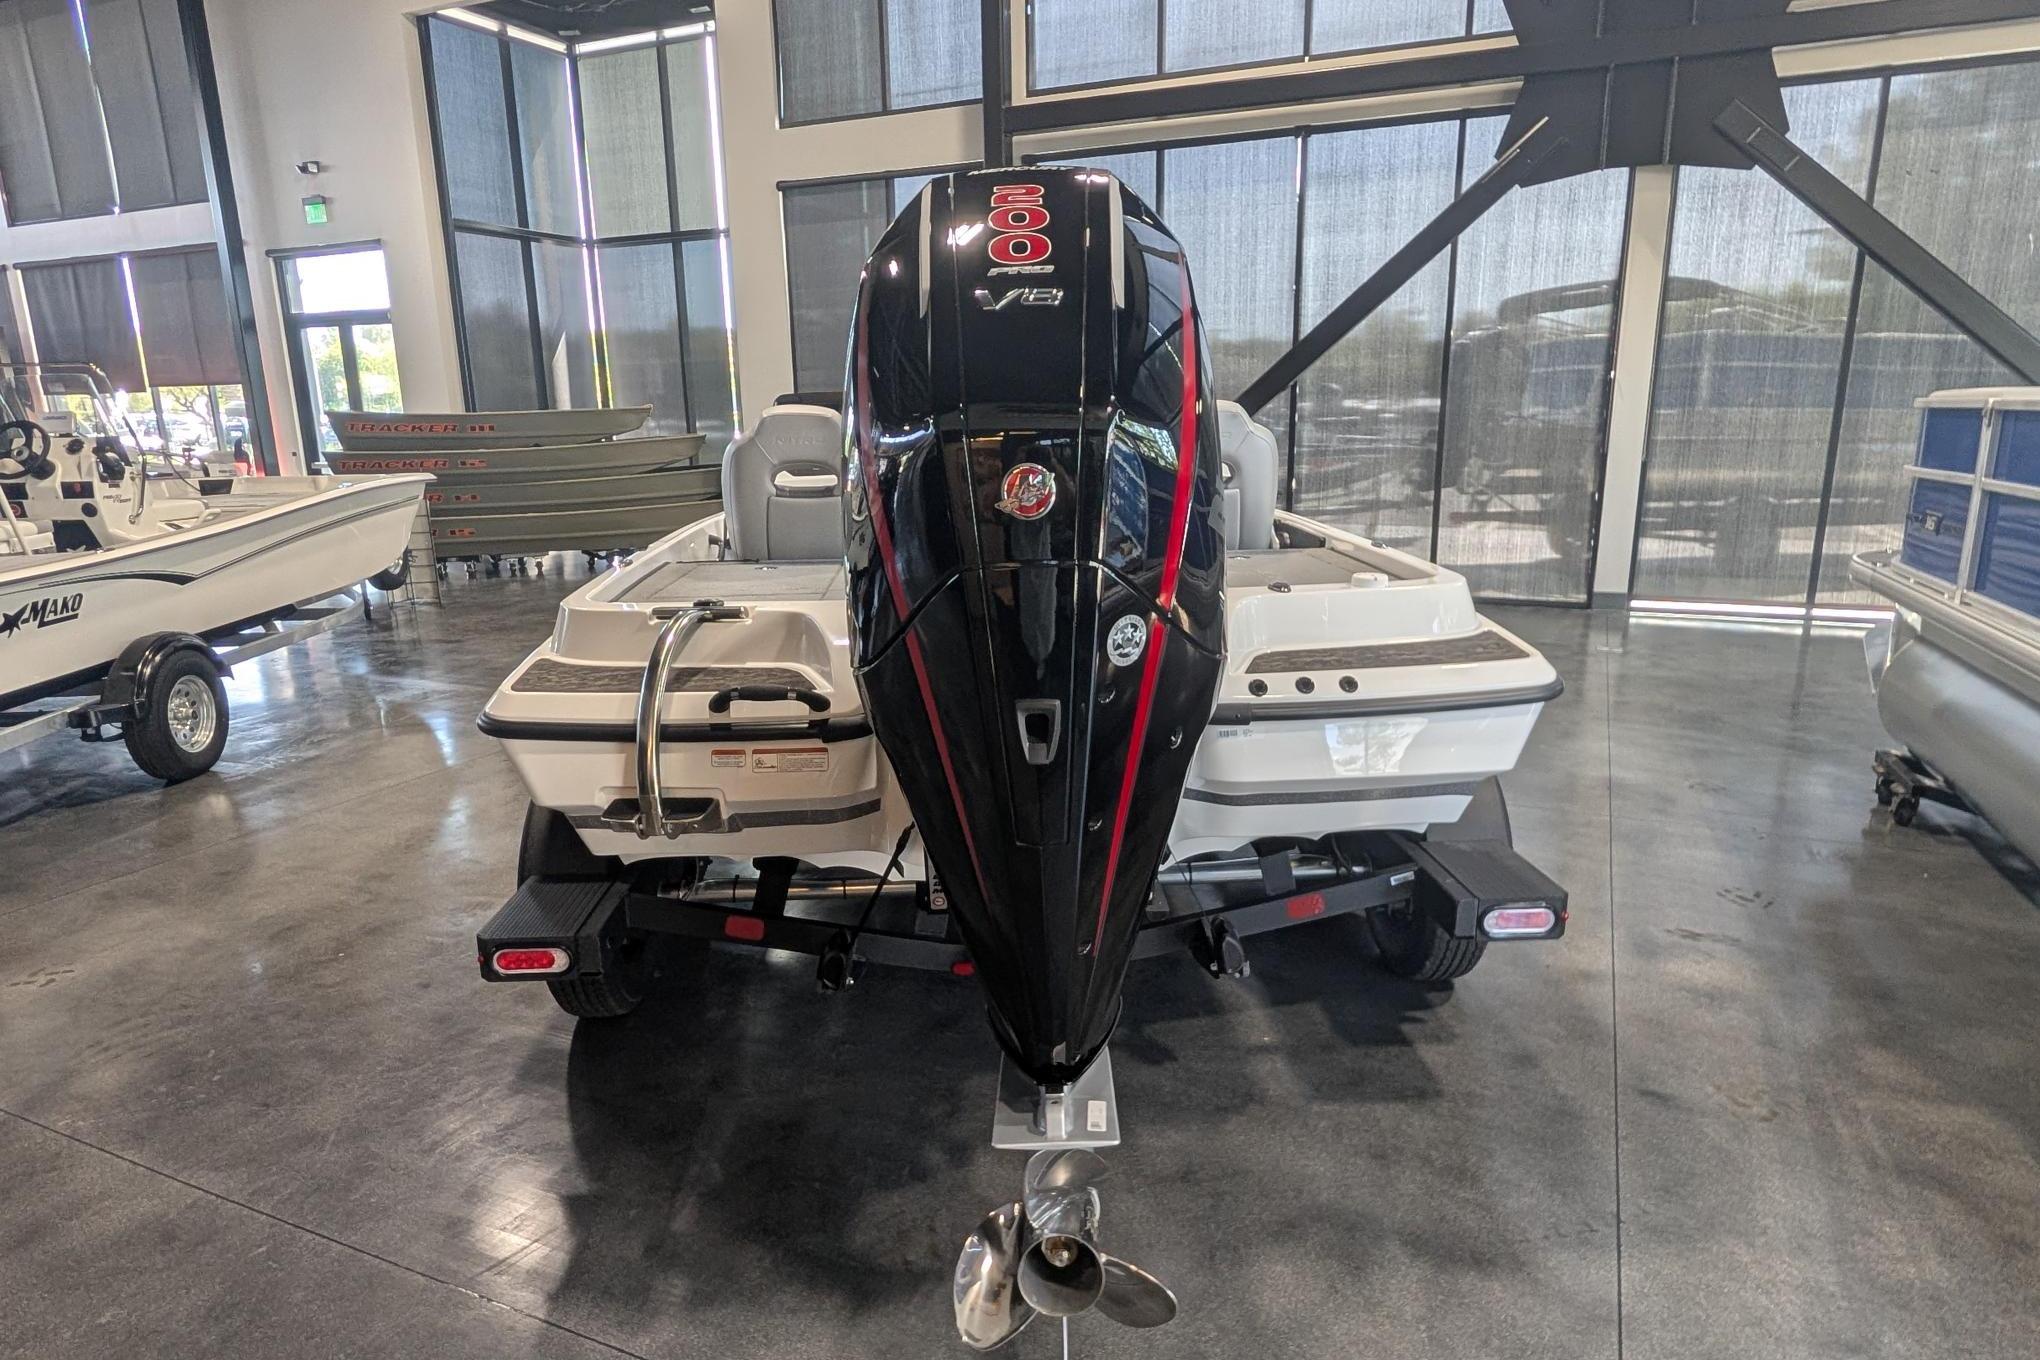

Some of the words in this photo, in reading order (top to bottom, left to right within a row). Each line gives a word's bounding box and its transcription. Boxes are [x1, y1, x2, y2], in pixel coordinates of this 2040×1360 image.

[988, 184, 1052, 265] 200
[346, 421, 459, 434] TRACKER
[338, 459, 449, 471] TRACKER
[21, 593, 83, 629] MAKO
